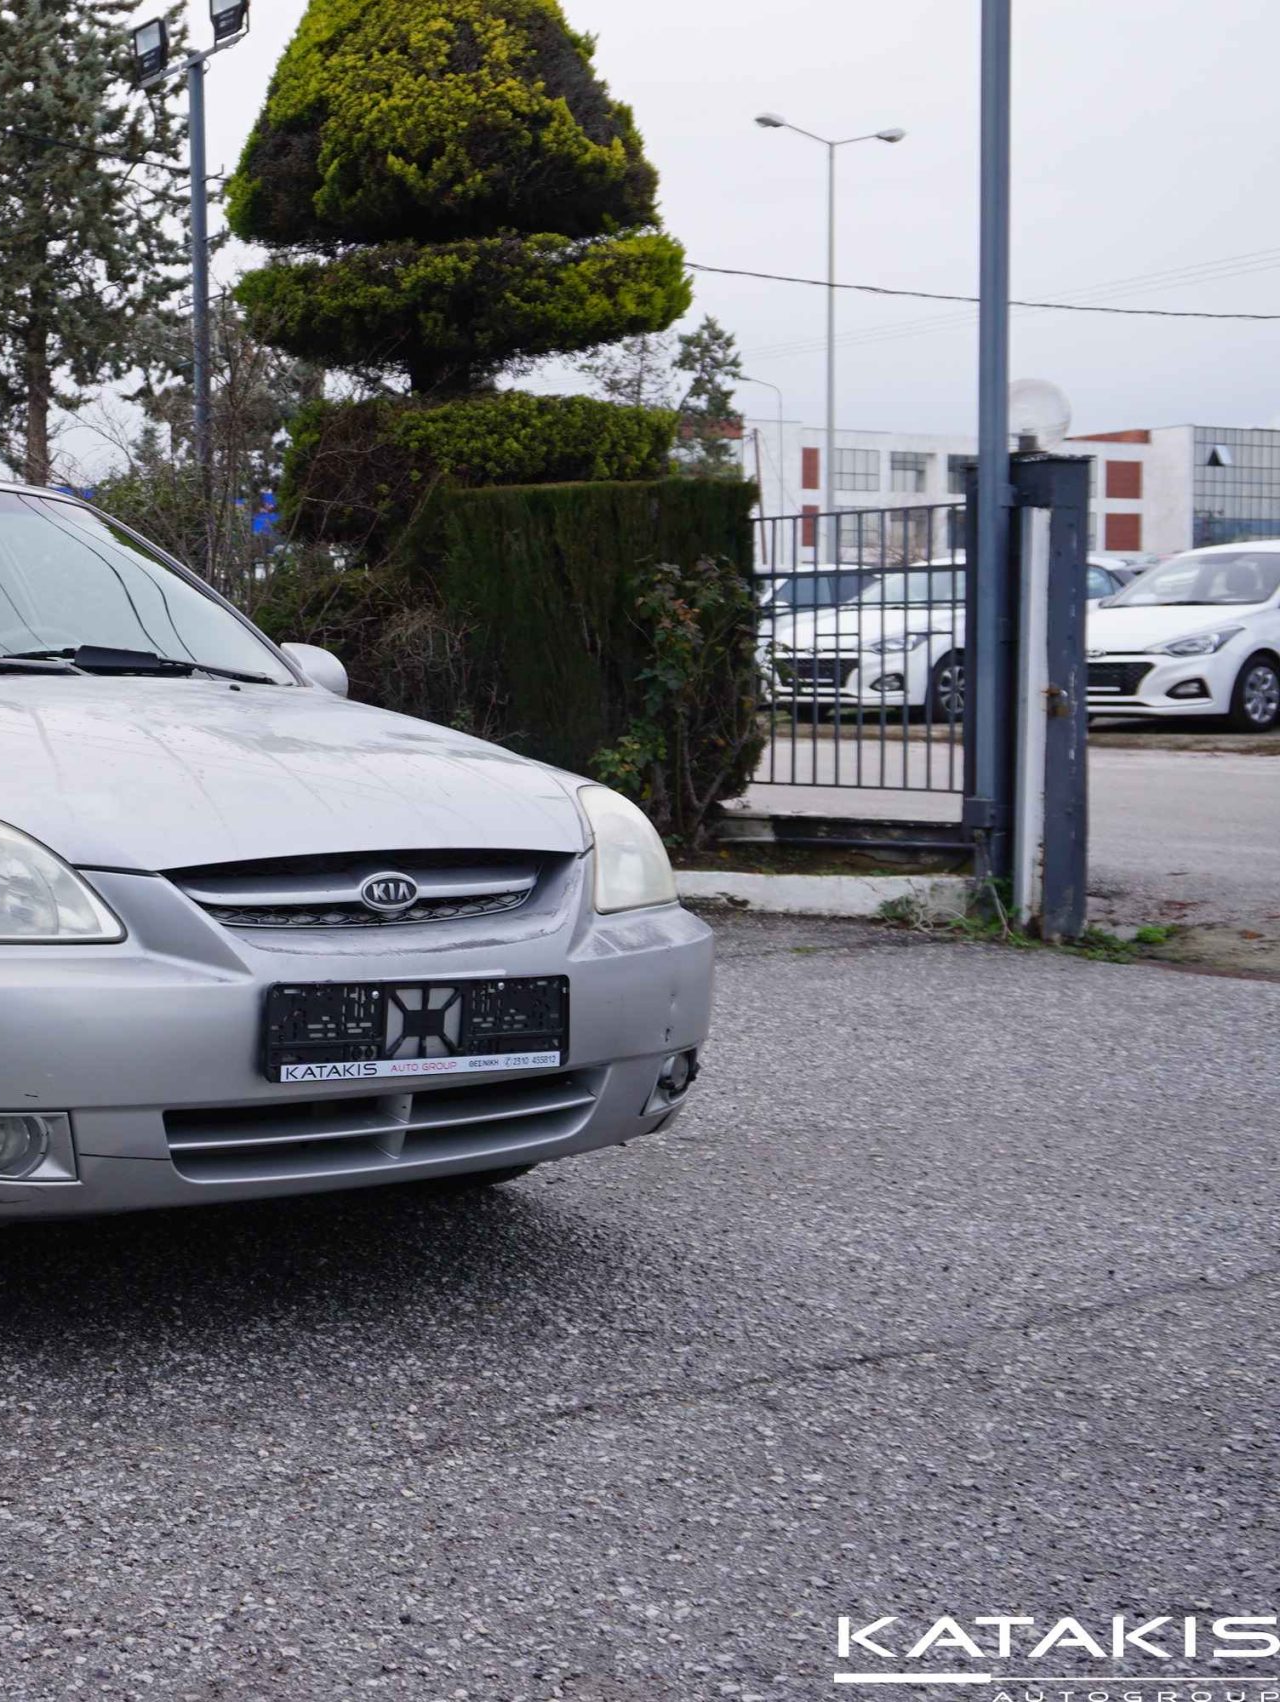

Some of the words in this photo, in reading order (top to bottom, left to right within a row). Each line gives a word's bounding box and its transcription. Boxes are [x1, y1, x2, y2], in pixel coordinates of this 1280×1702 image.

[371, 882, 412, 901] KIA
[285, 1062, 378, 1080] KATAKIS
[390, 1063, 419, 1072] AUTO
[422, 1061, 458, 1071] GROUP
